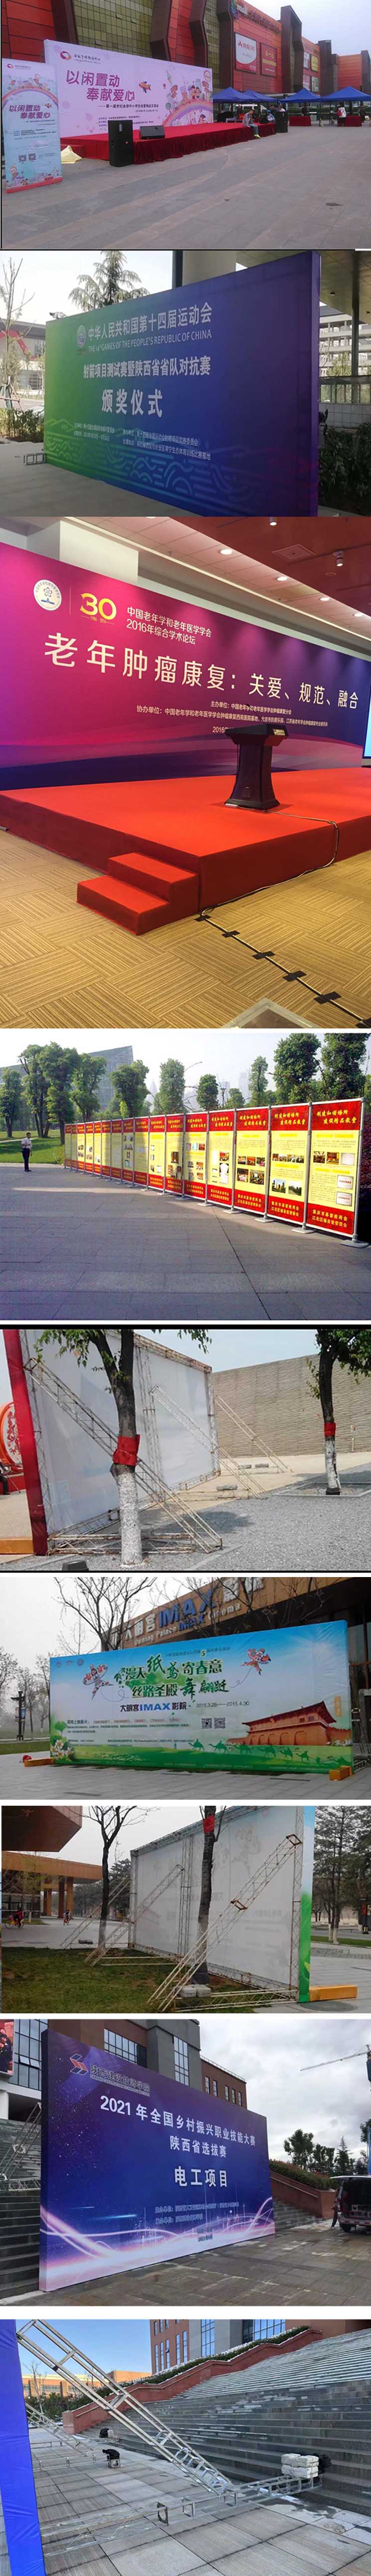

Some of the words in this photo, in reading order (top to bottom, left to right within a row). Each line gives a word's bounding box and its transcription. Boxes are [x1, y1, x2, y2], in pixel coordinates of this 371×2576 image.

[66, 70, 120, 87] 以闲置动
[86, 88, 135, 101] 奉献爱心
[88, 302, 212, 340] 中华人民共和国第十四届运动会
[131, 336, 154, 347] PEOPLE'S
[154, 333, 181, 344] REPUBLIC
[182, 332, 190, 341] OF
[191, 329, 212, 340] CHINA
[83, 355, 210, 378] 射箭项目测试赛暨陕西省省队对抗赛
[102, 388, 163, 418] 颁奖仪式
[80, 593, 117, 620] 30
[126, 619, 195, 644] 2016年综合学术论坛
[127, 607, 211, 638] 中国老年学和老年医学学会
[90, 2064, 150, 2093] 陕西建设技师学院
[170, 2135, 226, 2158] 陕西省选拔赛
[175, 2166, 227, 2187] 电工项目
